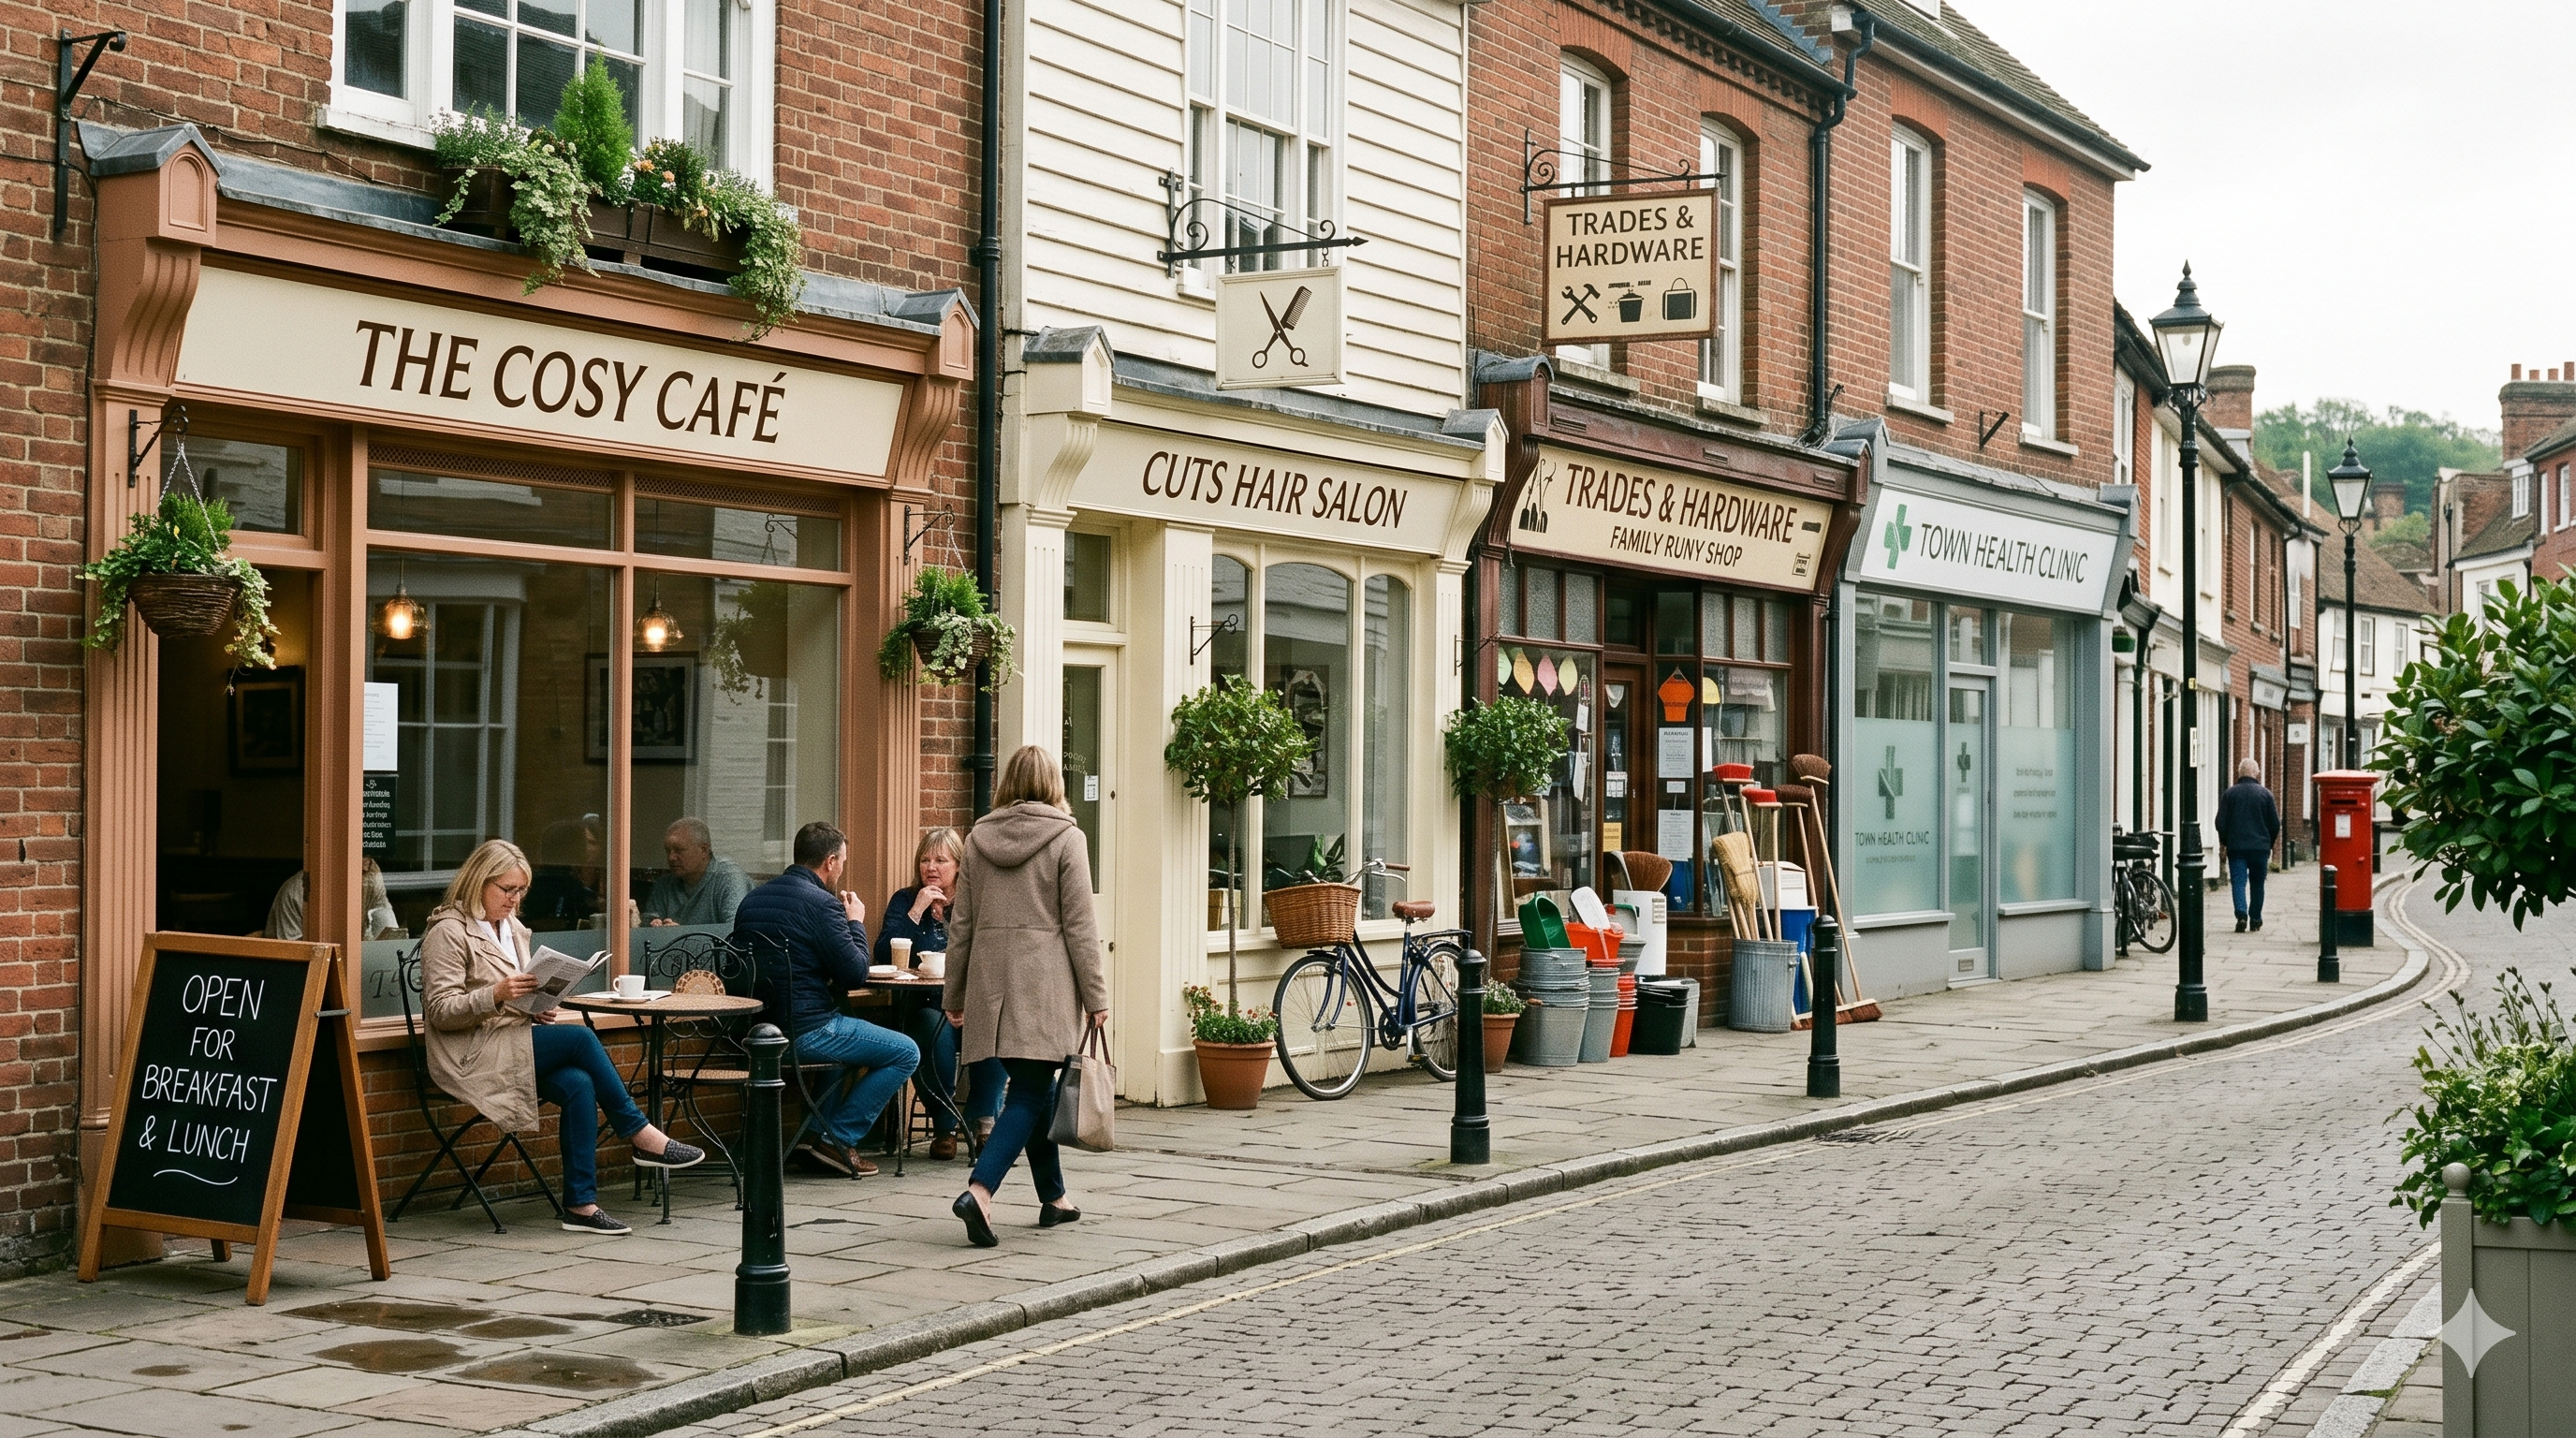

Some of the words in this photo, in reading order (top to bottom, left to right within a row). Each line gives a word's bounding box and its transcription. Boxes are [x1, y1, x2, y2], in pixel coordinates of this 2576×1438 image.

[1566, 207, 1667, 237] TRADES
[1676, 205, 1694, 229] &
[1556, 236, 1704, 269] HARDWARE
[356, 319, 479, 401] THE
[493, 345, 649, 422] COSY
[656, 371, 787, 444] CAFÉ
[1142, 450, 1228, 505] CUTS
[1231, 463, 1309, 515] HAIR
[1311, 477, 1408, 529] SALON
[1566, 462, 1656, 520] TRADES
[1658, 483, 1676, 523] &
[1678, 487, 1798, 544] HARDWARE
[1610, 525, 1664, 555] FAMILY
[1664, 535, 1705, 562] RUNY
[1705, 542, 1743, 567] SHOP
[1921, 522, 1971, 565] TOWN
[1974, 533, 2037, 577] HEALTH
[2038, 545, 2088, 583] CLINIC
[1855, 832, 1876, 846] TOWN
[1878, 831, 1904, 845] HEALTH
[1906, 830, 1930, 844] CLINIC
[183, 975, 265, 1020] OPEN
[190, 1026, 235, 1061] FOR
[141, 1064, 278, 1113] BREAKFAST
[139, 1115, 156, 1150] &
[168, 1120, 250, 1163] LUNCH
